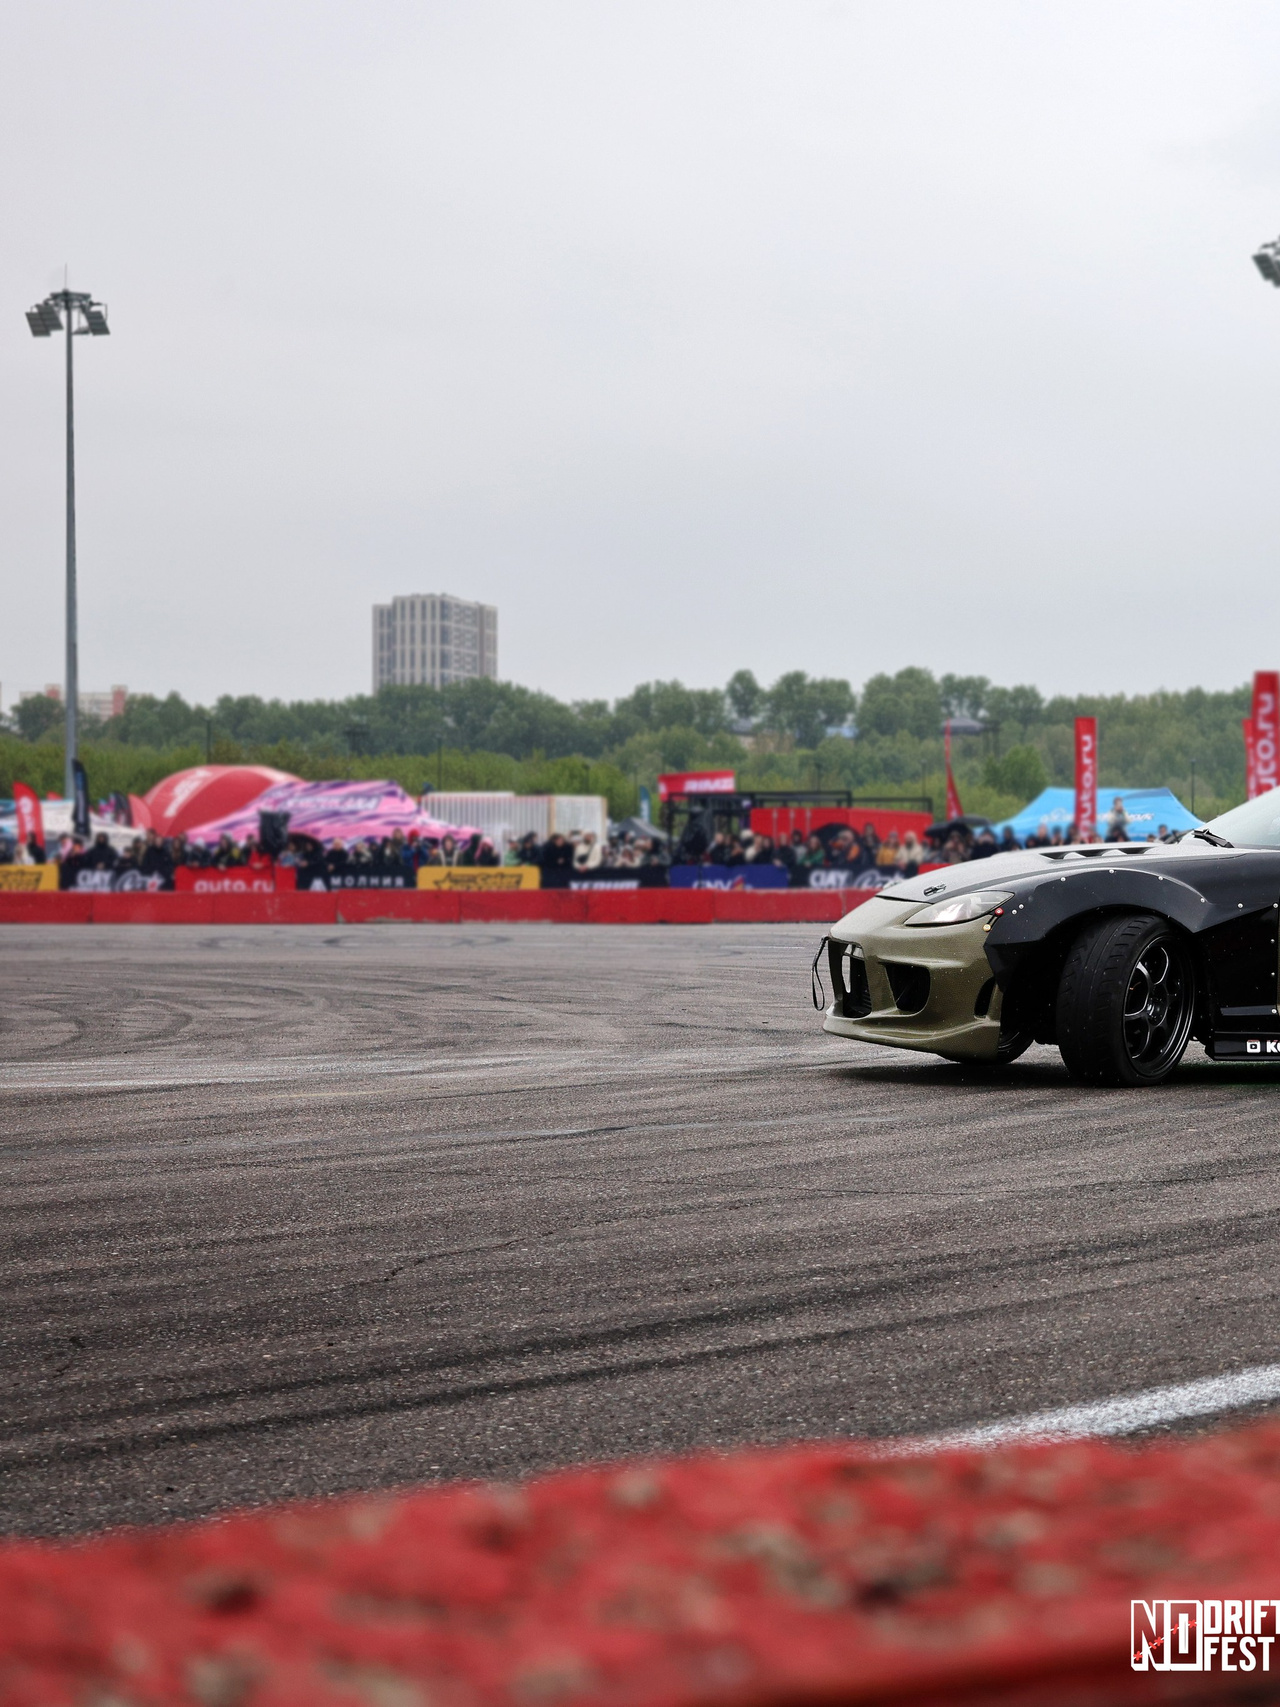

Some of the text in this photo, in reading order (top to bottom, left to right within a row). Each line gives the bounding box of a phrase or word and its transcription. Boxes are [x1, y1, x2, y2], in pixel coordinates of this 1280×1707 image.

[1256, 693, 1277, 796] uto.ru
[194, 878, 274, 893] auto.ru
[331, 875, 404, 887] МОЛНИЯ
